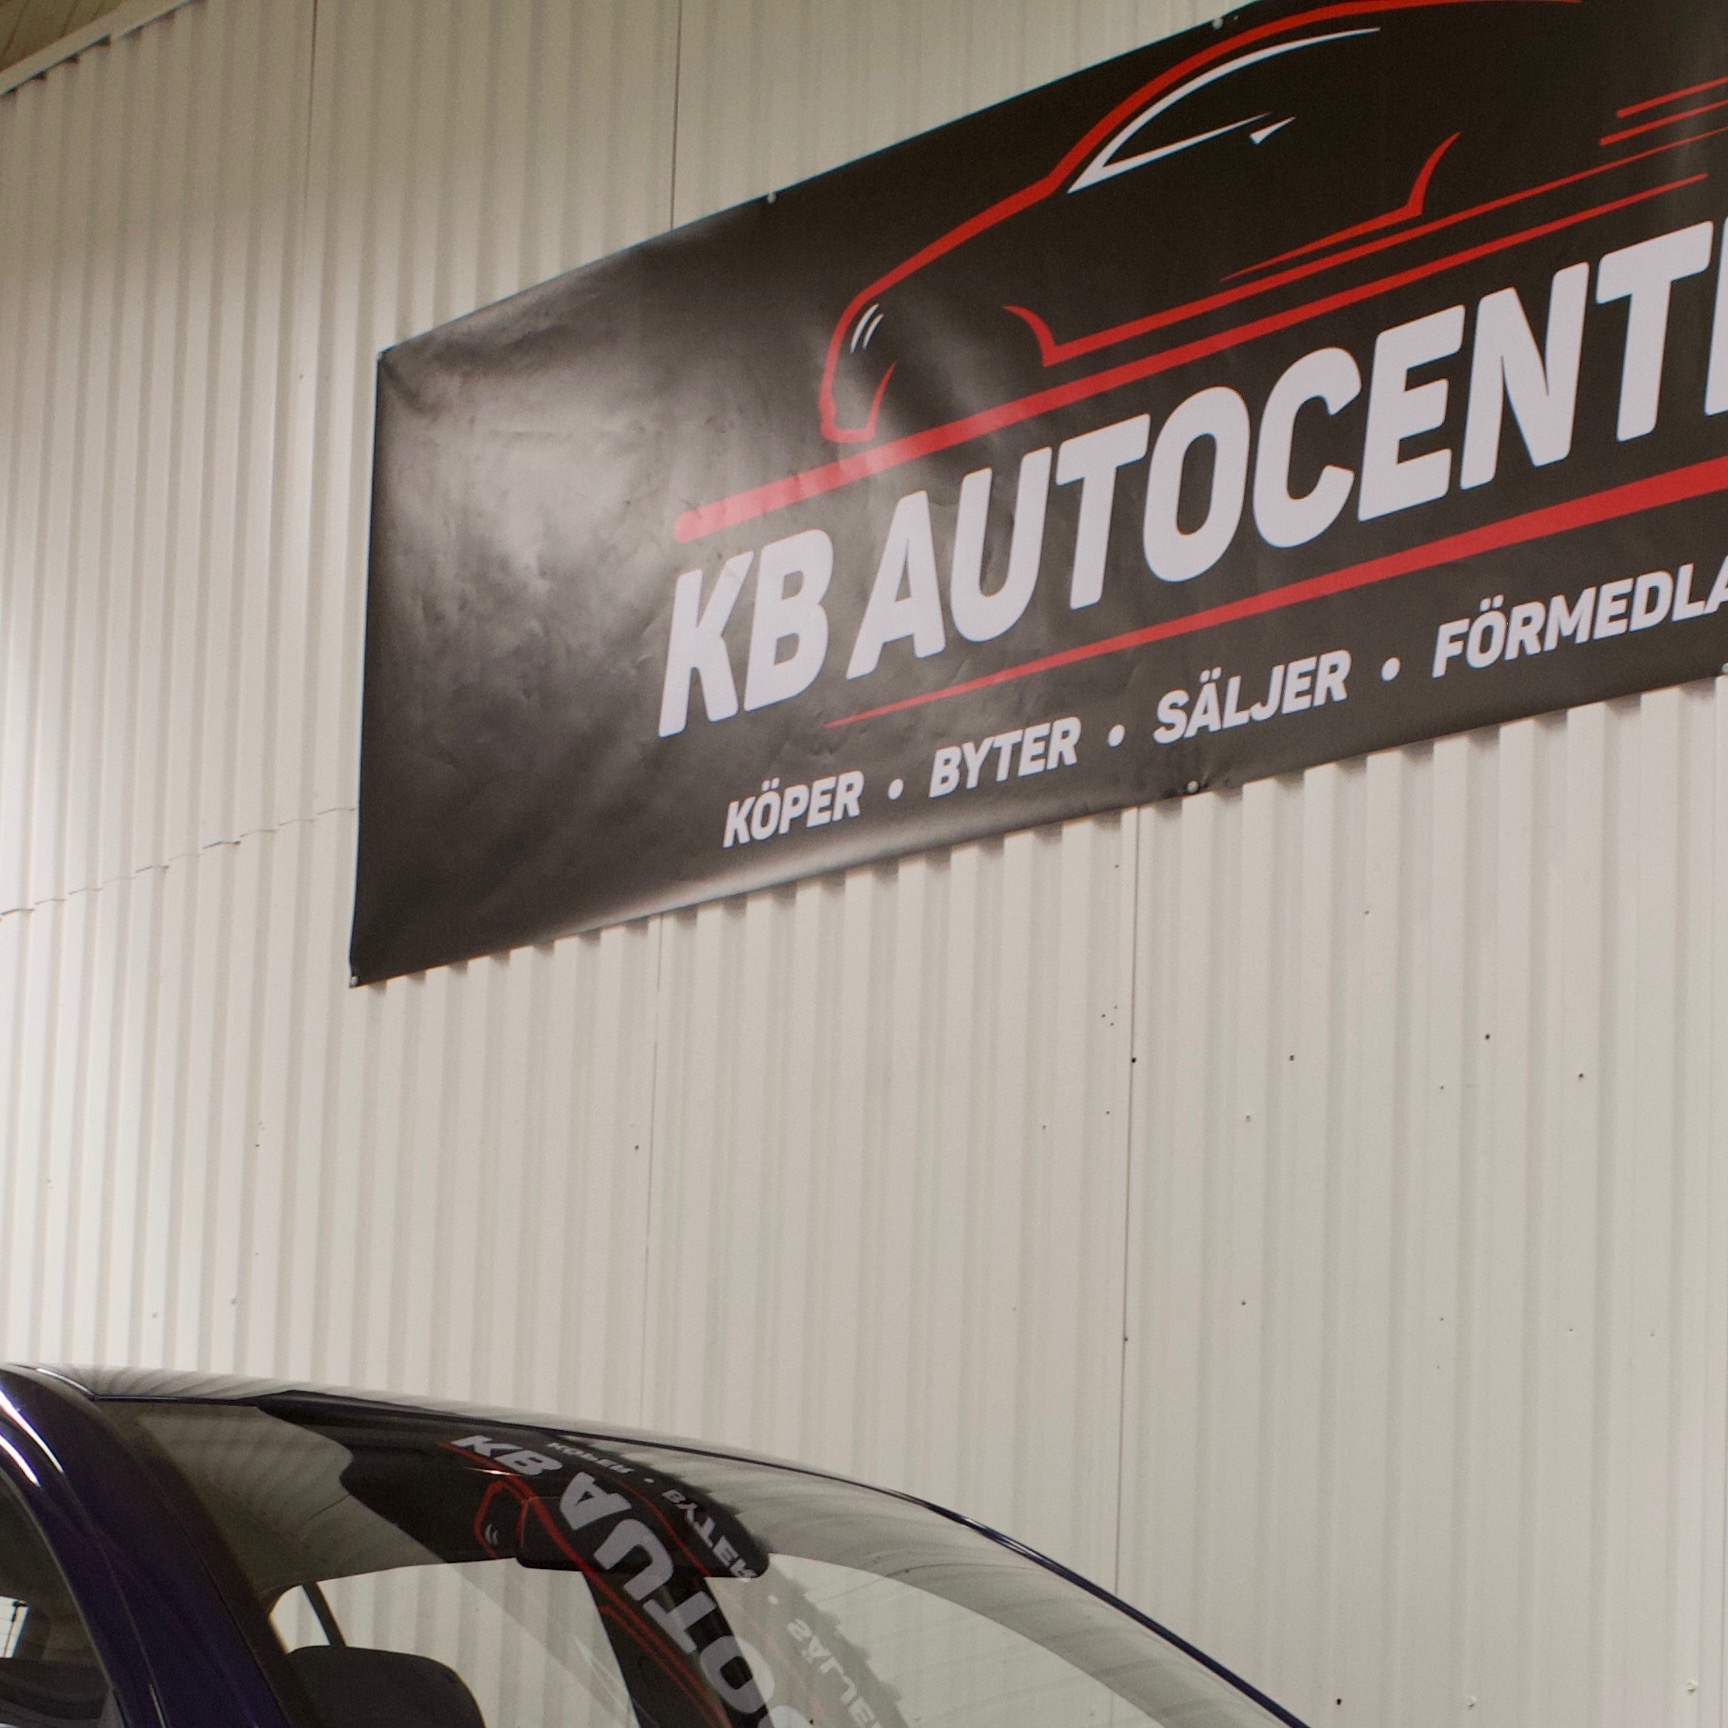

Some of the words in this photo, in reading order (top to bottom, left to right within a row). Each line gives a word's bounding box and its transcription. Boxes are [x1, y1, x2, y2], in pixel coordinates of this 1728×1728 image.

[658, 528, 834, 738] KB
[722, 770, 865, 849] KÖPER
[929, 717, 1082, 799] BYTER
[1153, 649, 1352, 745] SÄLJER
